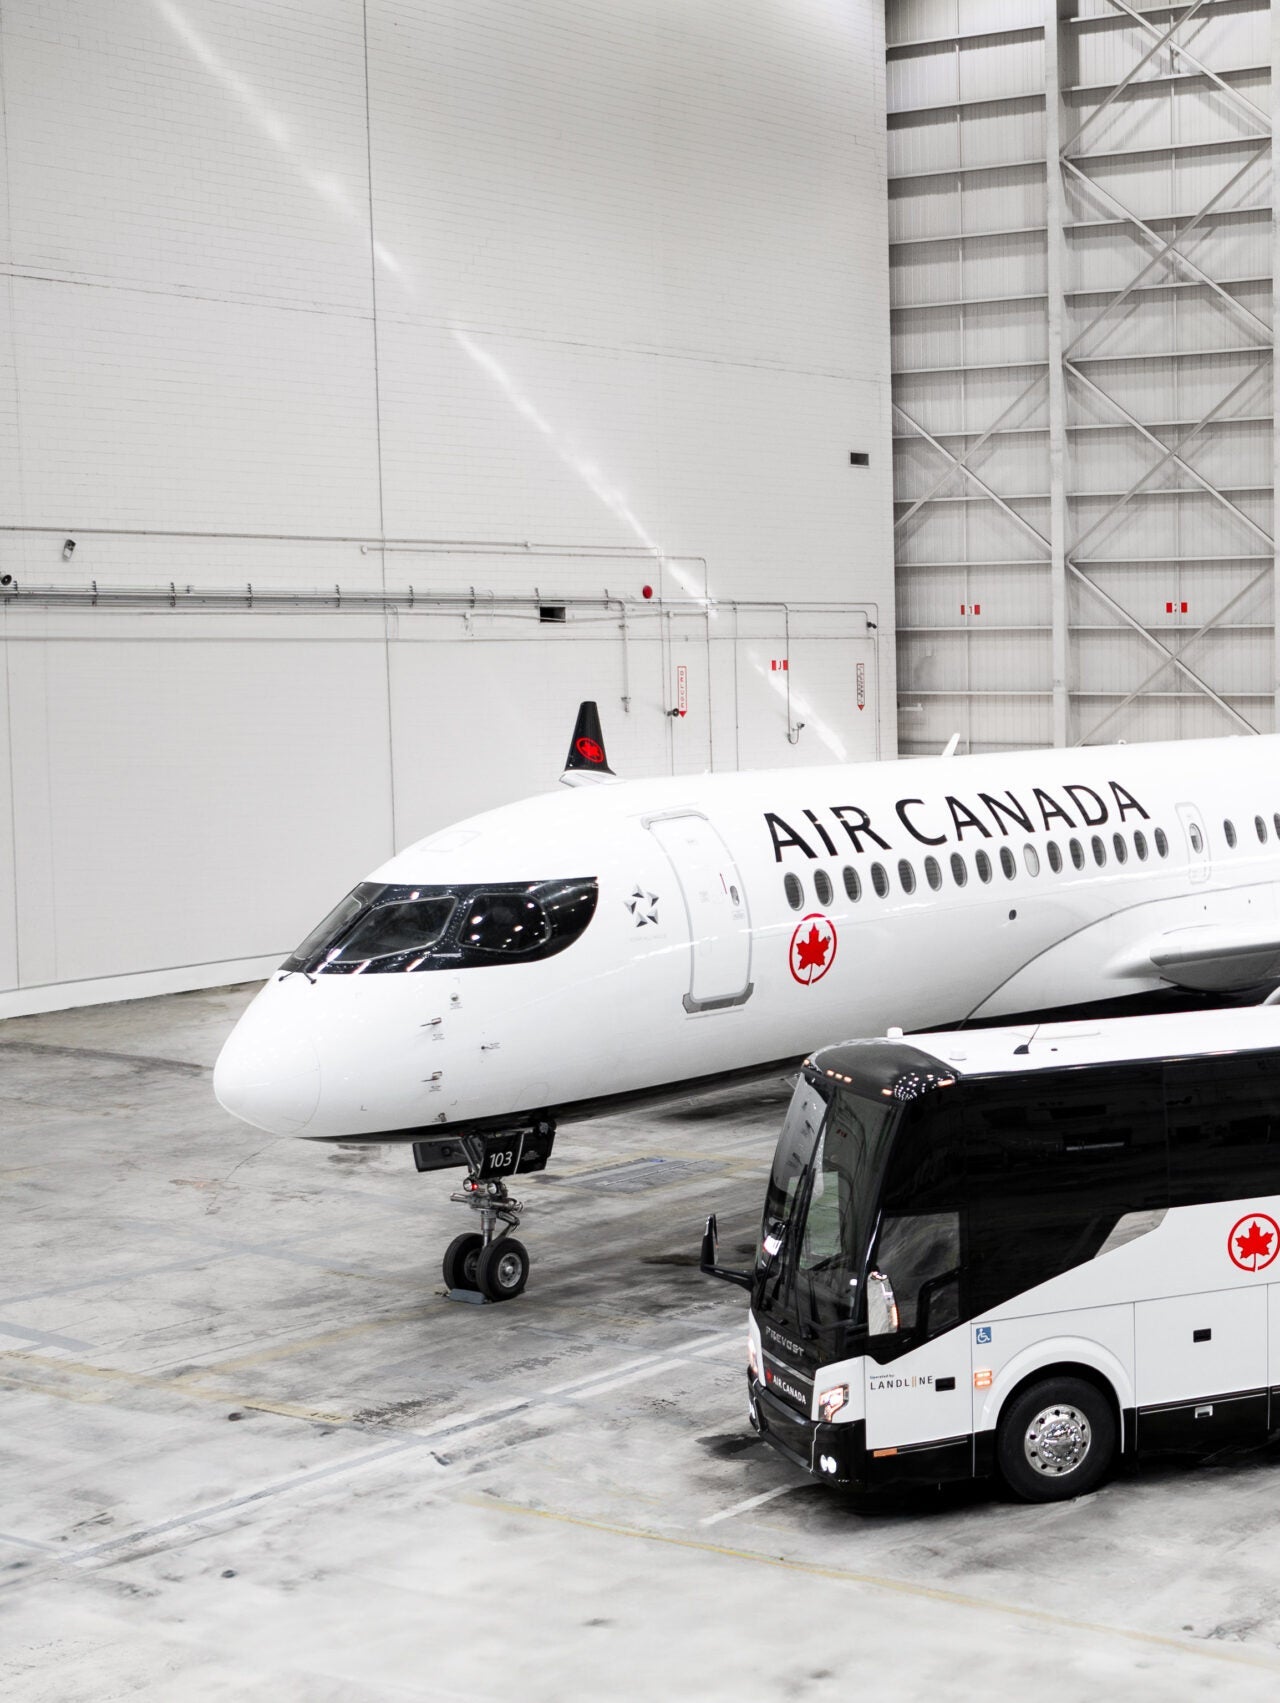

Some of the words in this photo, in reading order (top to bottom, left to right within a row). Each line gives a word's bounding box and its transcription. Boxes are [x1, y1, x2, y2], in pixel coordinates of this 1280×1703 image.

[763, 805, 893, 863] AIR
[895, 781, 1151, 847] CANADA
[490, 1151, 513, 1168] 103
[765, 1325, 805, 1357] PREVOST
[773, 1375, 783, 1388] AIR
[782, 1381, 807, 1405] CANADA
